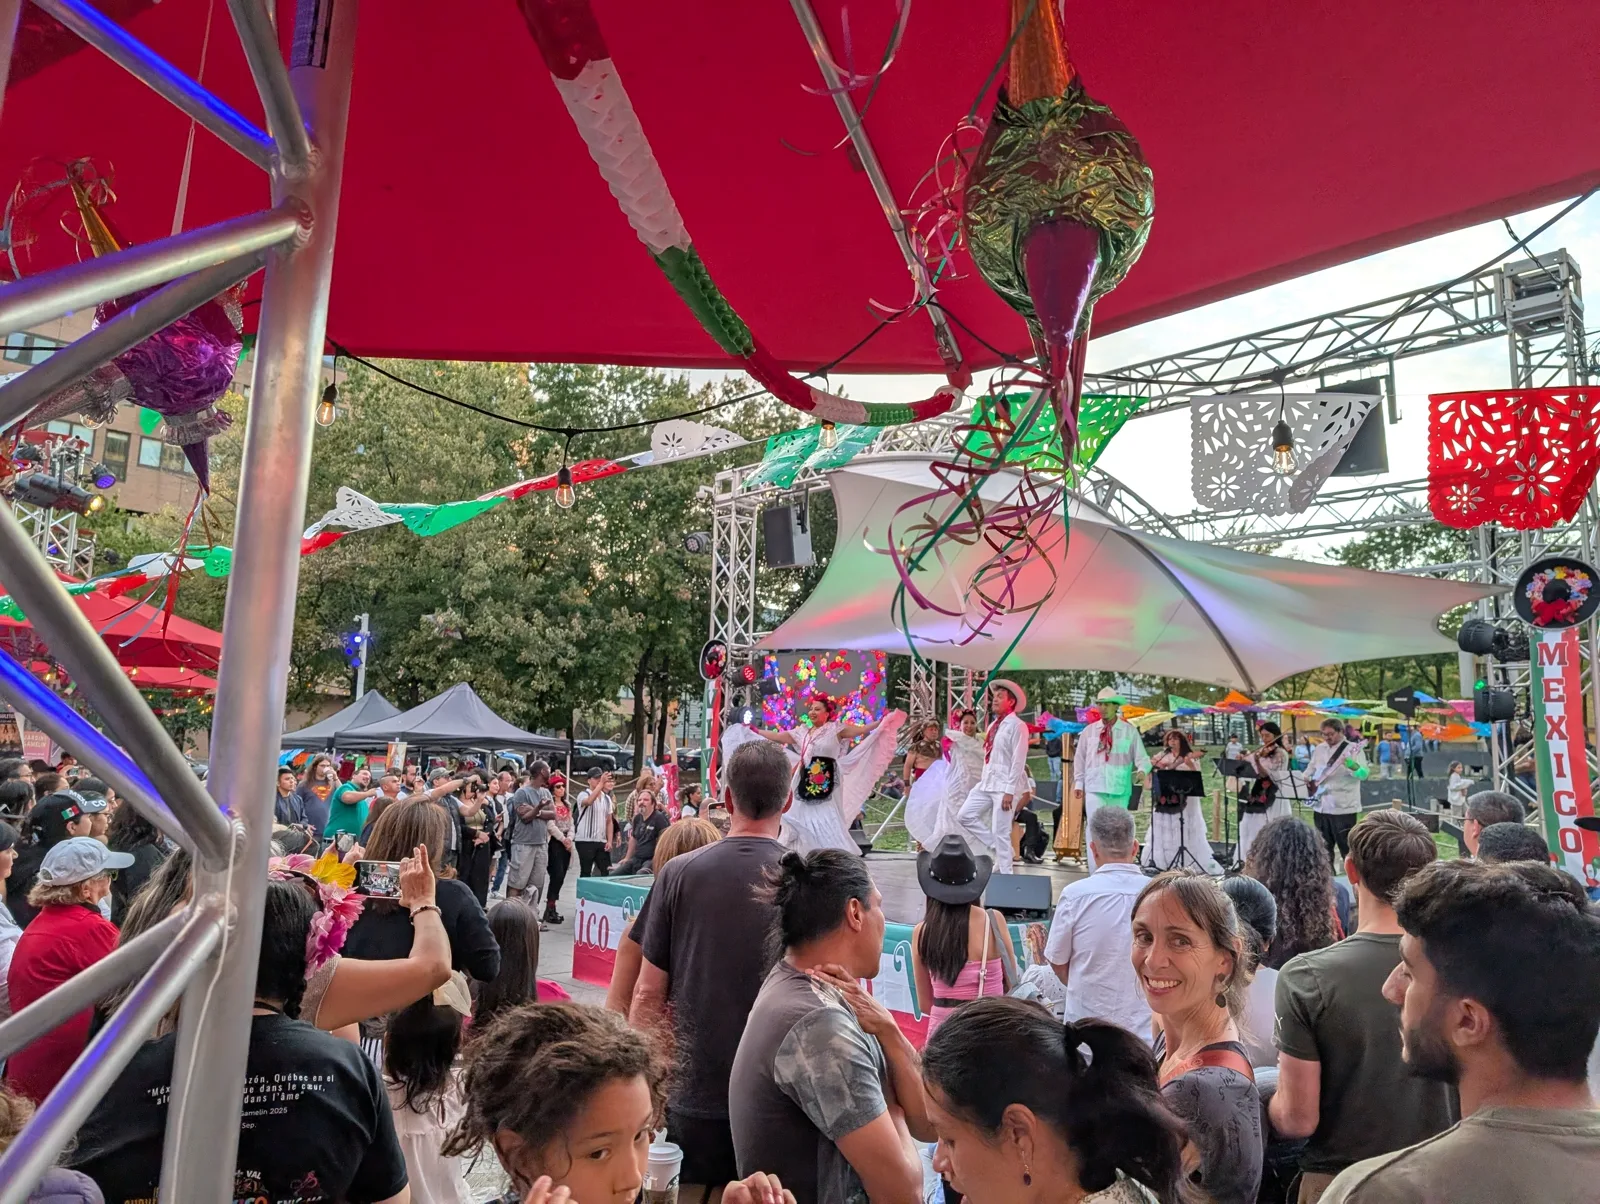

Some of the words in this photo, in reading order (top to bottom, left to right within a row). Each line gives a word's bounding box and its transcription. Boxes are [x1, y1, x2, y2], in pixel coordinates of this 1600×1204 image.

[1537, 641, 1584, 853] MEXICO
[274, 1073, 309, 1082] Québec
[327, 1074, 334, 1082] el
[260, 1084, 283, 1092] dans
[287, 1082, 297, 1091] le
[244, 1095, 267, 1104] dans
[240, 1108, 268, 1117] Gamelin
[269, 1106, 288, 1115] 2025
[241, 1122, 257, 1130] Sep.
